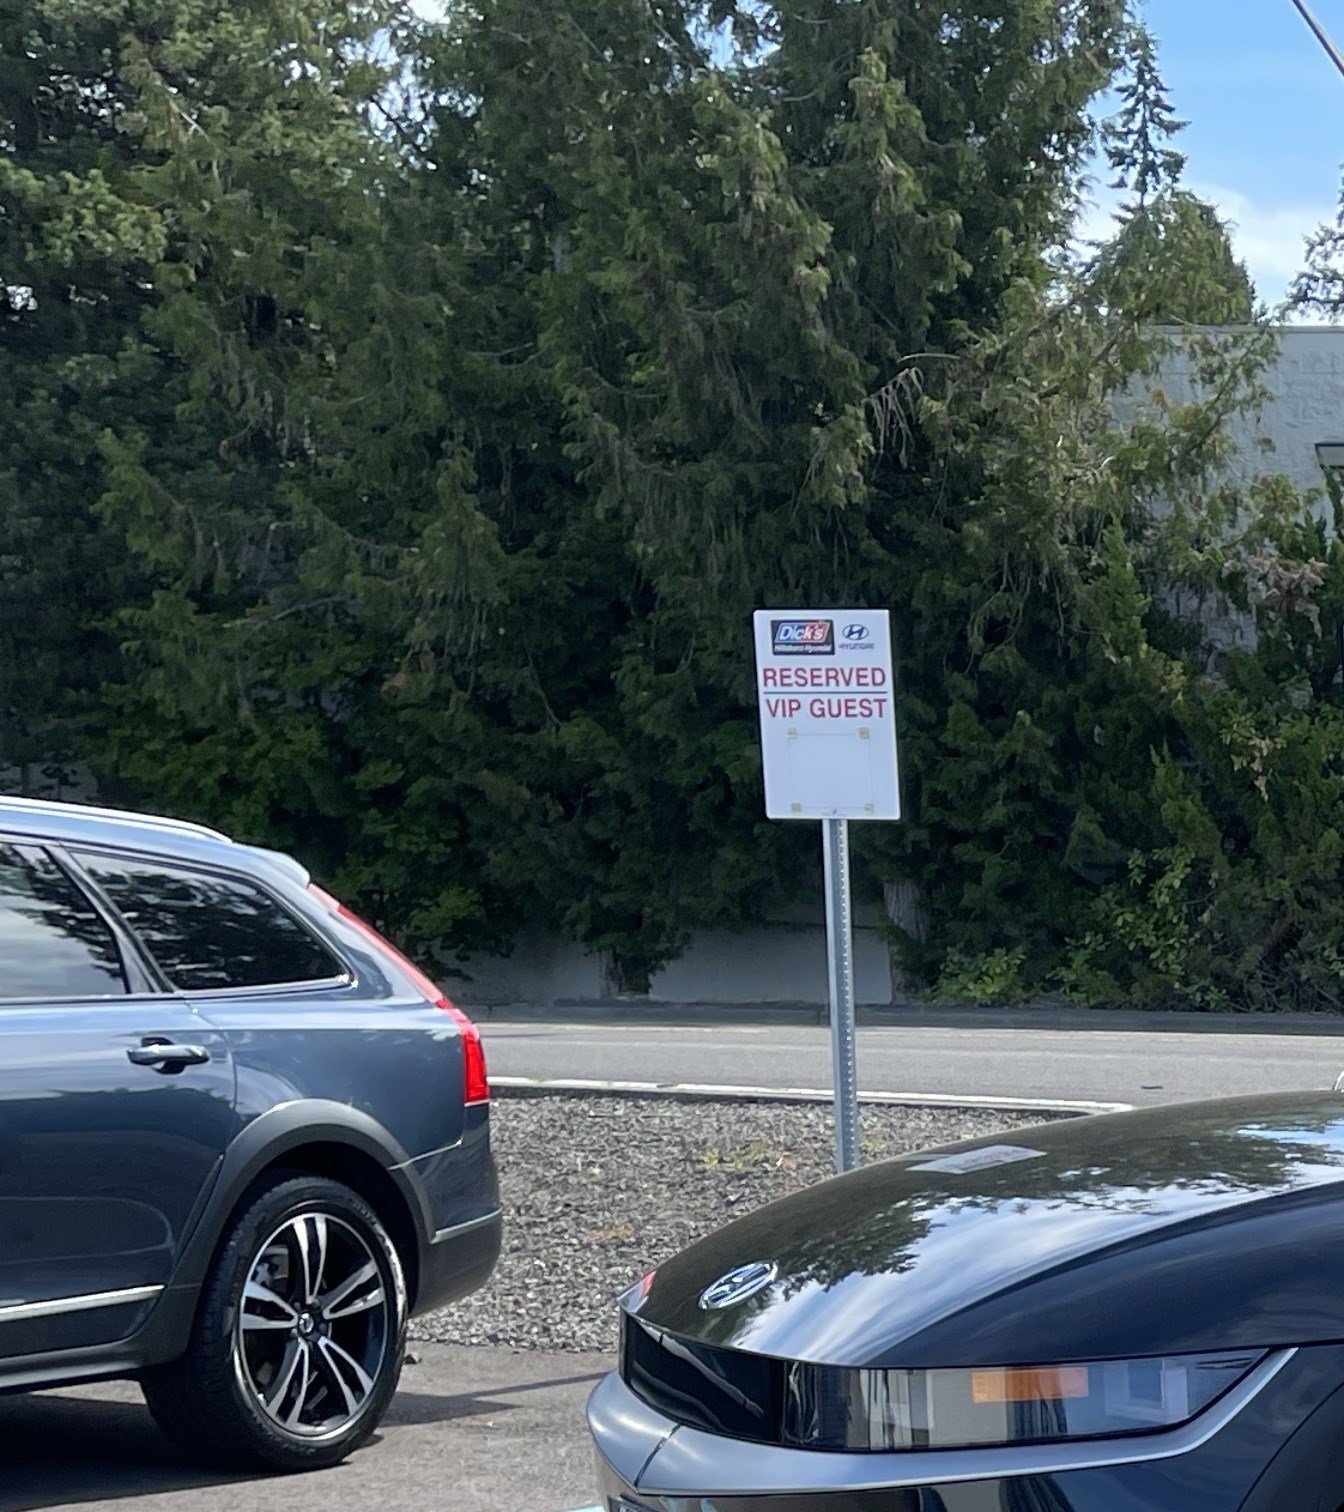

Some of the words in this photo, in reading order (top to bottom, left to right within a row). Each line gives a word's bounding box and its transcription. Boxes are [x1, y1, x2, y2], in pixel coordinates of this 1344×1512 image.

[780, 624, 826, 641] Dick's
[763, 667, 886, 687] RESERVED
[766, 698, 801, 718] VIP
[810, 698, 887, 718] GUEST
